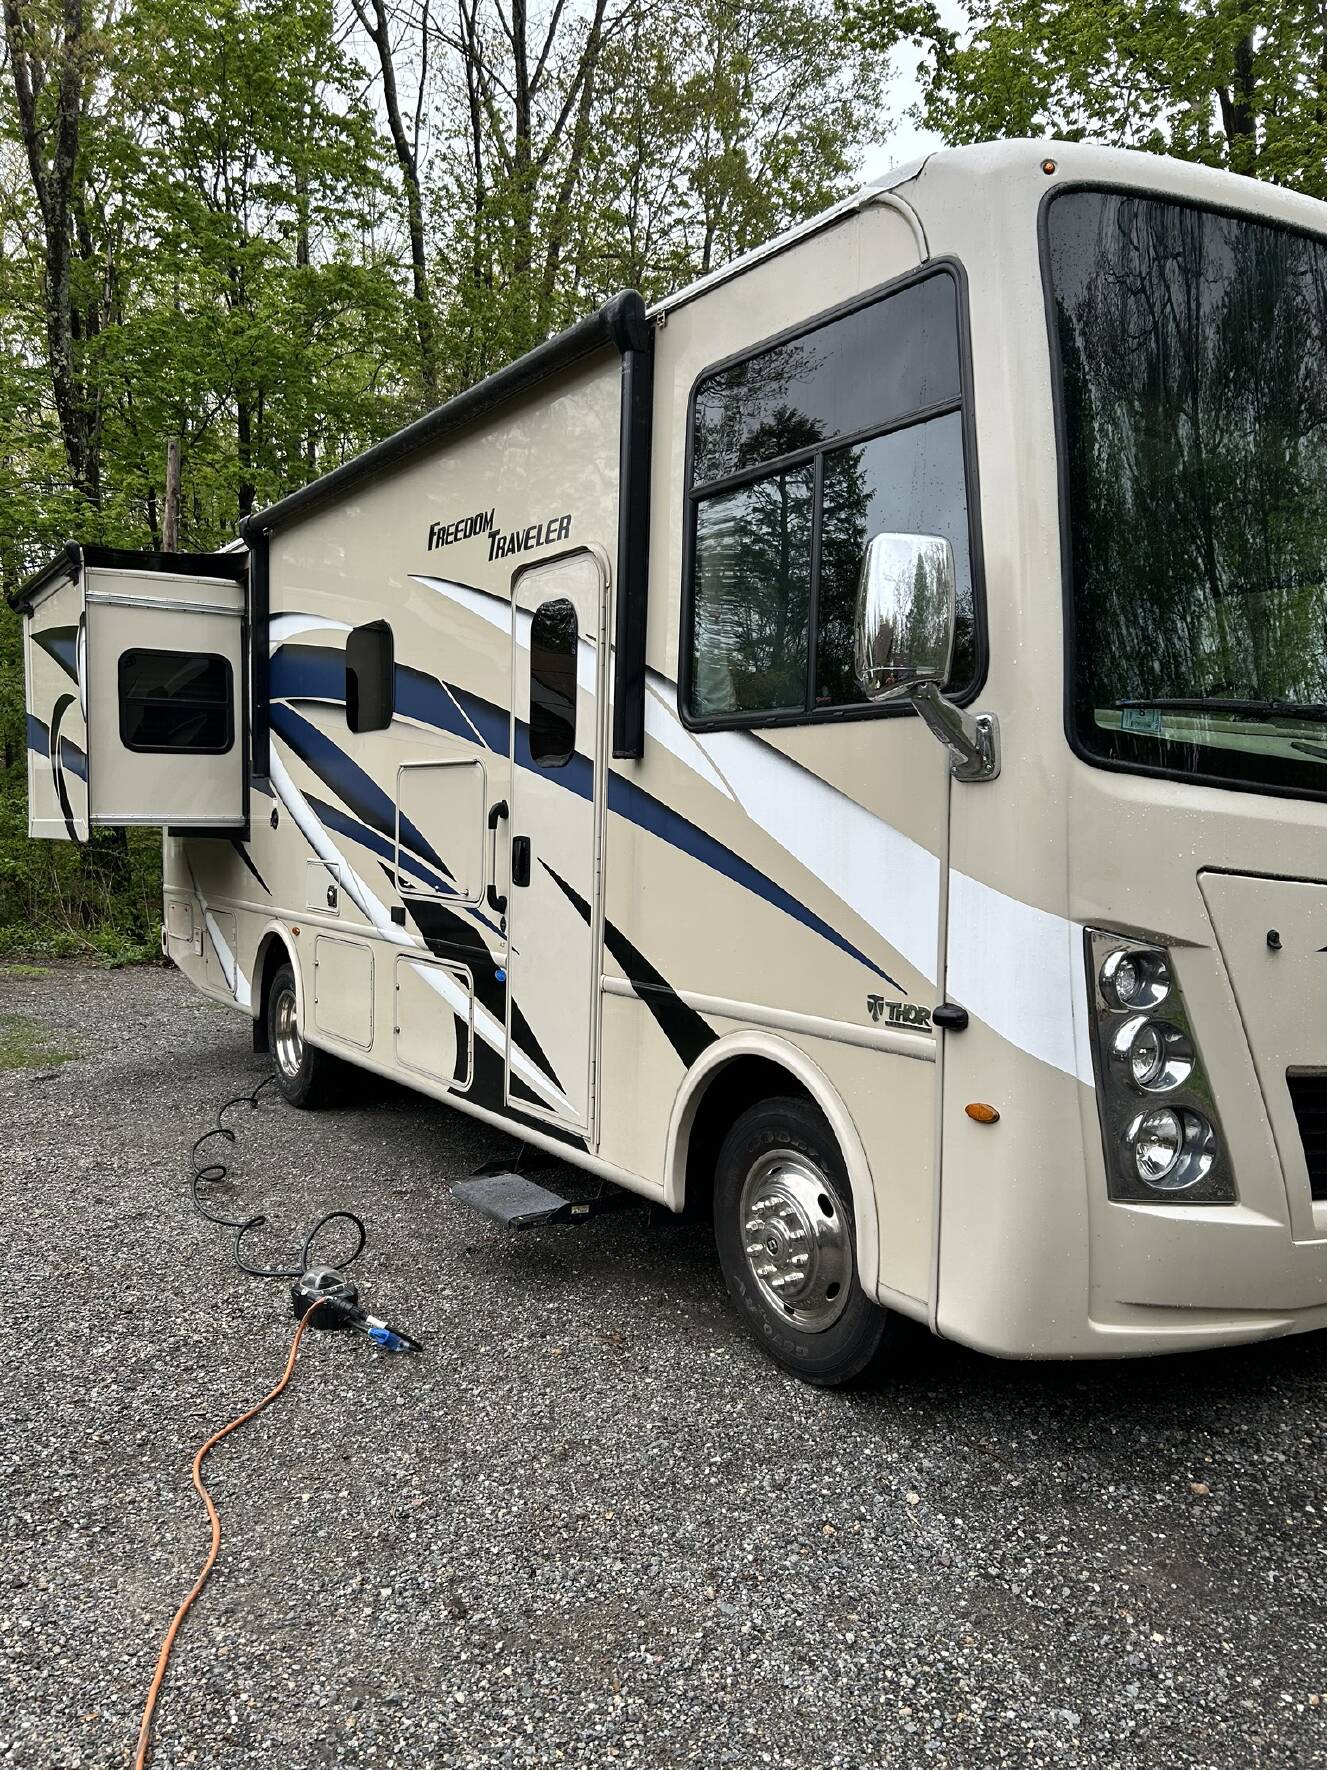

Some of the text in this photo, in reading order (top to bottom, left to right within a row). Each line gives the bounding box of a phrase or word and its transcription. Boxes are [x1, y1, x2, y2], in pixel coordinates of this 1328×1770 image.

[427, 507, 496, 552] FREEDOM
[487, 514, 572, 562] TRAVELER
[884, 1001, 932, 1028] THOR
